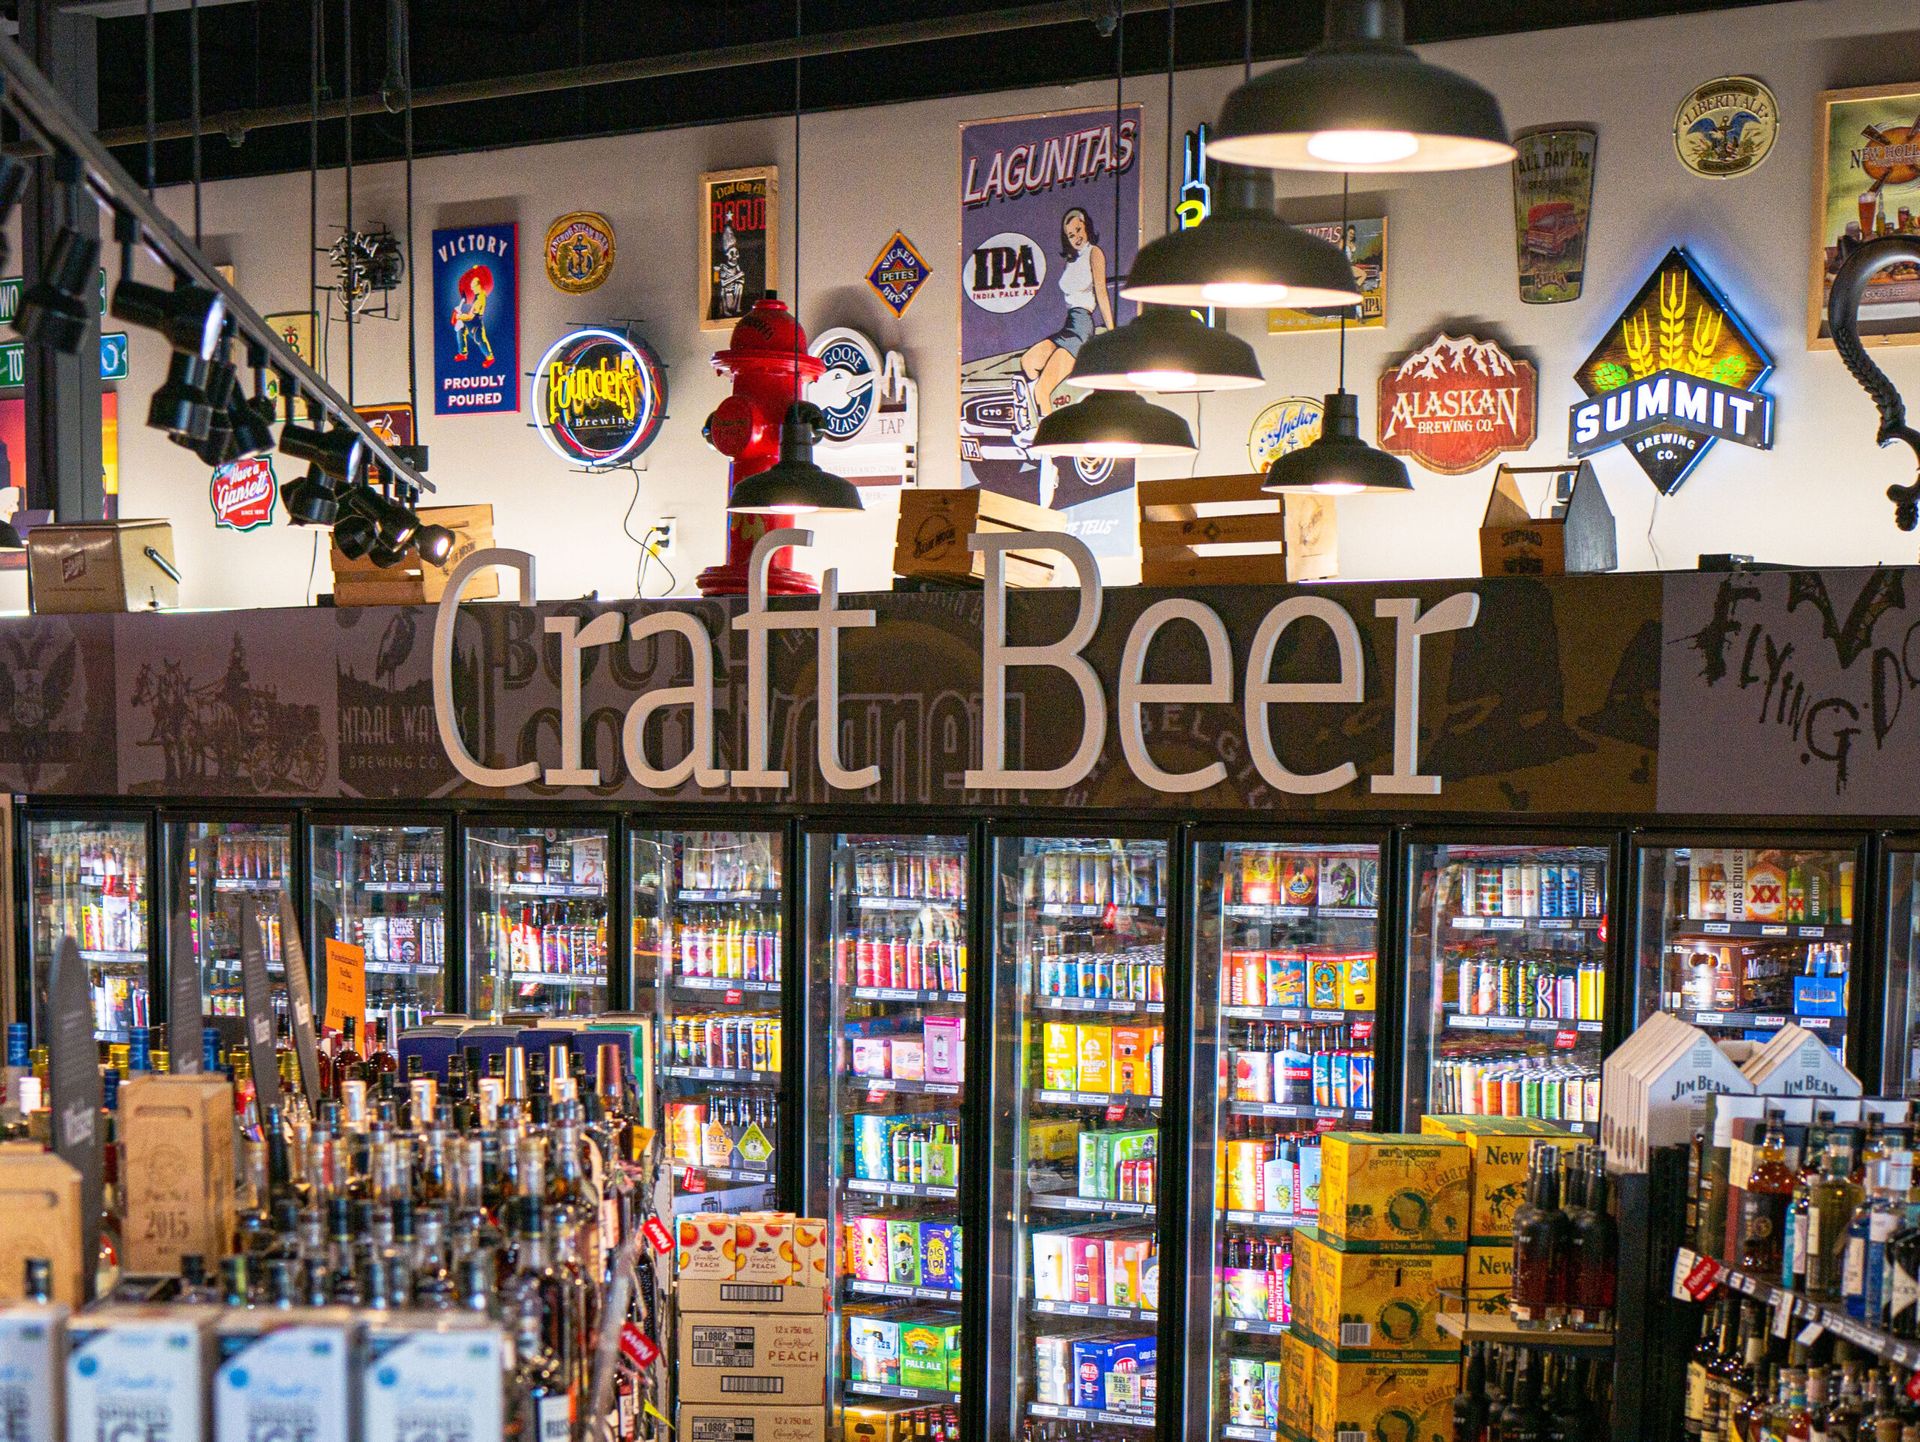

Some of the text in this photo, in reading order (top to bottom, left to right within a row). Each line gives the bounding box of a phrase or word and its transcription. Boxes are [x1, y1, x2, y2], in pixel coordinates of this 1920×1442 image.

[1684, 94, 1768, 124] LIBERTY ALE
[963, 119, 1137, 206] LAGUNITAS
[438, 234, 508, 263] VICTORY
[881, 249, 916, 270] WICKED
[972, 244, 1040, 292] IPA
[972, 291, 996, 300] INDIA
[999, 290, 1020, 299] PALE
[1365, 298, 1380, 312] IPA
[823, 346, 865, 372] GOOSE
[443, 374, 506, 390] PROUDLY
[549, 356, 636, 425] Founders
[448, 392, 503, 407] POURED
[1382, 386, 1522, 442] ALASKAN
[1575, 377, 1755, 444] SUMMIT
[575, 415, 636, 428] Brewing
[878, 417, 905, 435] TAP
[1417, 418, 1495, 434] BREWING CO.
[962, 440, 981, 458] IPA
[1635, 432, 1696, 453] BREWING
[1656, 449, 1678, 460] CO.
[230, 464, 253, 486] Have
[432, 528, 882, 790] Craft
[964, 531, 1482, 796] Beer
[1686, 573, 1863, 795] FLYING
[348, 755, 413, 770] BREWING
[1732, 854, 1743, 915] DOS EQUIS
[1750, 884, 1781, 904] XX
[1353, 1023, 1373, 1031] New
[1556, 1032, 1576, 1040] New
[1671, 1075, 1731, 1101] JIM BEAM
[1804, 1075, 1838, 1094] BEAM
[1403, 1149, 1441, 1158] WISCONSIN
[1485, 1145, 1524, 1166] New
[1255, 1146, 1263, 1202] DESCHUTES
[143, 1211, 190, 1240] 2015
[648, 1223, 672, 1250] New
[694, 1261, 720, 1269] PEACH
[750, 1262, 777, 1270] PEACH
[1394, 1258, 1432, 1268] WISCONSIN
[1478, 1255, 1513, 1276] New
[1267, 1274, 1275, 1318] DESCHUTES
[703, 1331, 728, 1341] 10802
[774, 1326, 783, 1334] 12
[767, 1350, 820, 1361] PEACH
[904, 1359, 942, 1373] PALE ALE
[1391, 1367, 1429, 1377] WISCONSIN
[703, 1422, 728, 1432] 10802
